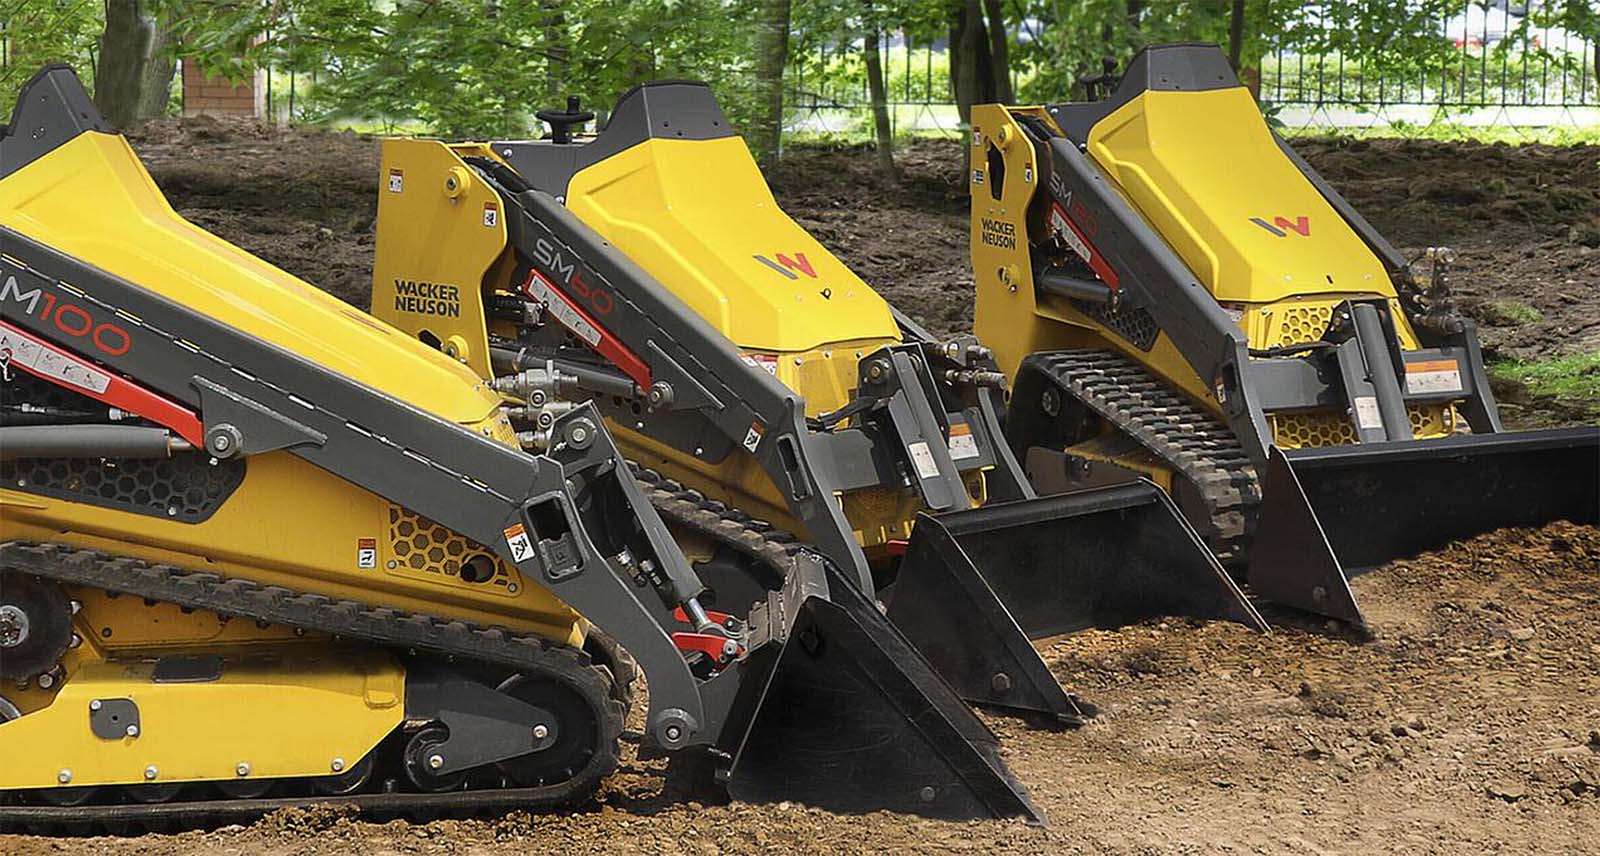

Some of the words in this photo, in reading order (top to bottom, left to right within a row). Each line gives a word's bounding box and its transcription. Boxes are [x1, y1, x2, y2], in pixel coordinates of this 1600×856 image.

[981, 216, 1016, 236] WACKER
[982, 231, 1016, 250] NEUSON
[394, 279, 460, 301] WACKER
[0, 270, 132, 356] M100
[395, 297, 460, 317] NEUSON
